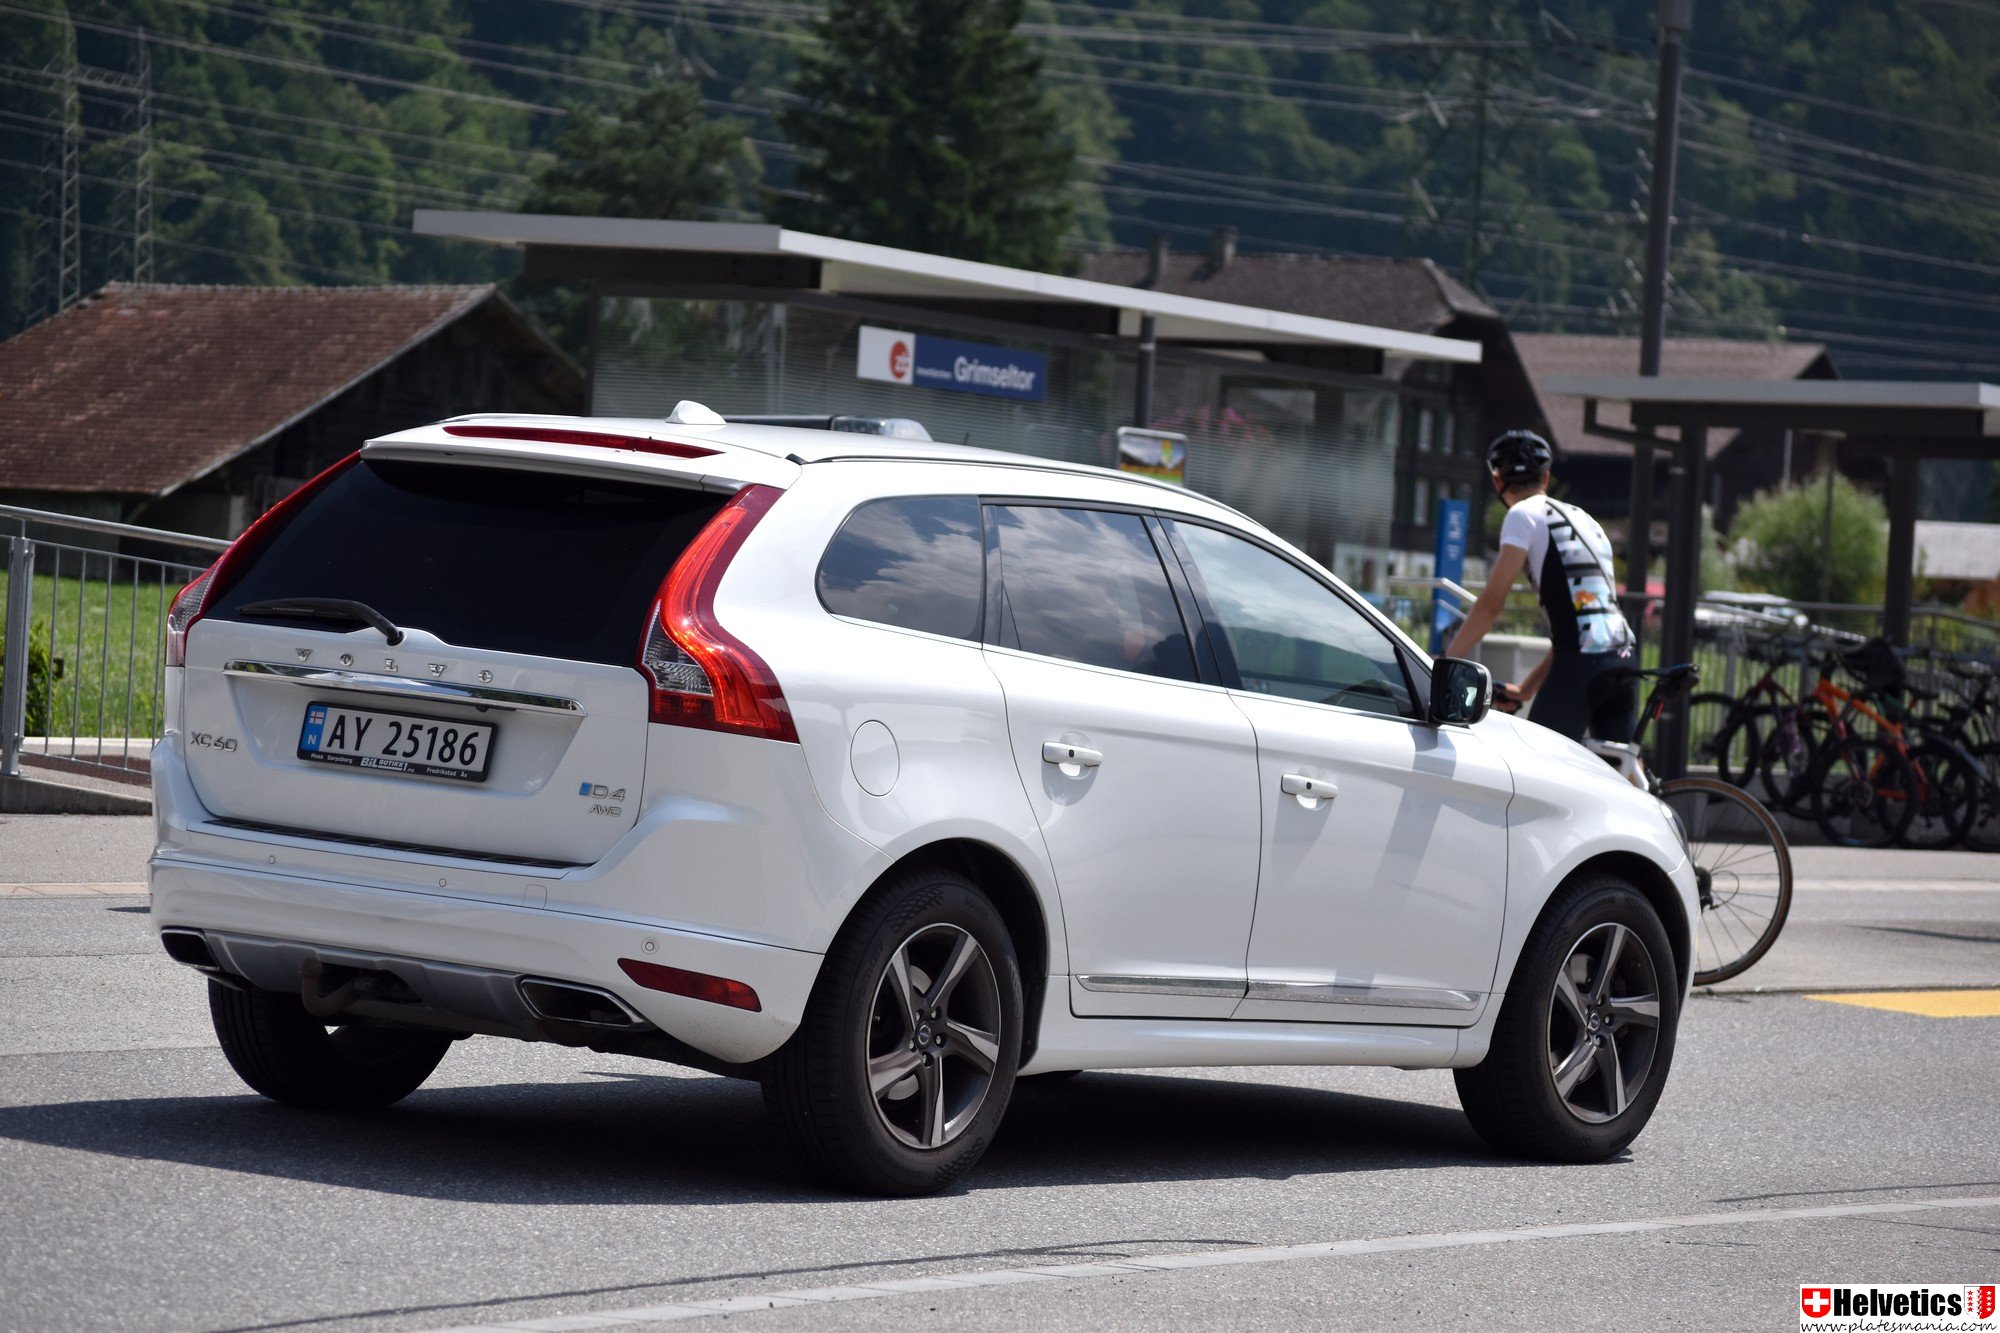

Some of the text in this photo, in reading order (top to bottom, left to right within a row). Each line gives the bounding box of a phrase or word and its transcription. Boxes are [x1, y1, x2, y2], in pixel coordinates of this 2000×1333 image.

[954, 356, 1036, 391] Grimseltor
[295, 648, 494, 684] VOLVO
[190, 731, 238, 752] XC60
[307, 734, 317, 745] N
[327, 715, 479, 766] AY 25186
[310, 752, 353, 764] Moss Sarpsborg
[426, 767, 457, 777] Fredrikstad
[591, 784, 626, 802] D4
[589, 804, 622, 817] AWD
